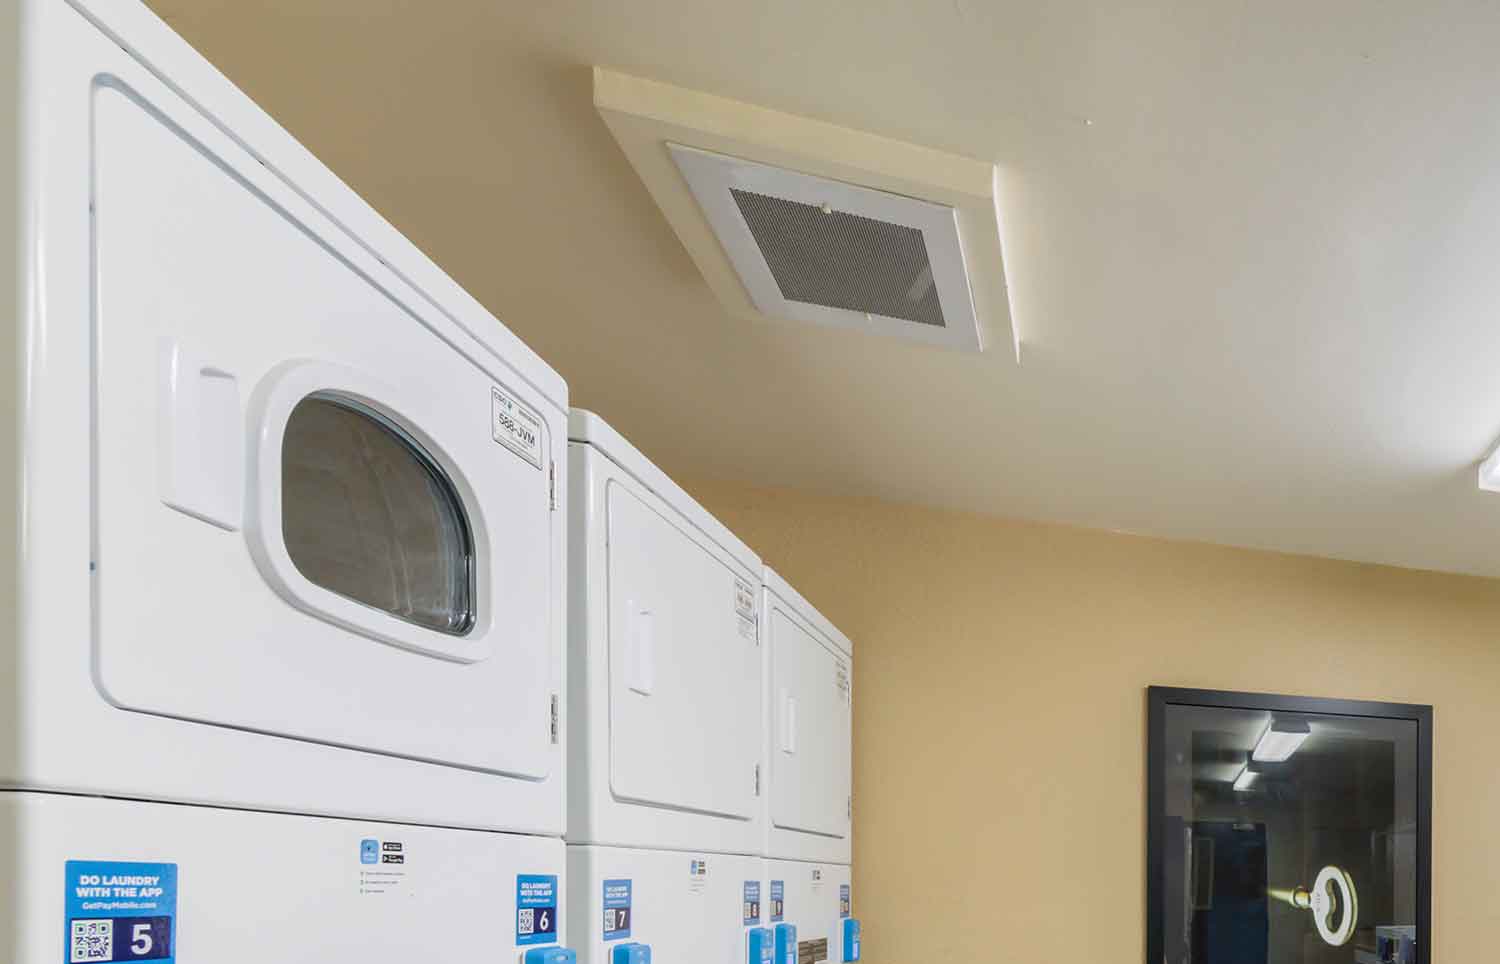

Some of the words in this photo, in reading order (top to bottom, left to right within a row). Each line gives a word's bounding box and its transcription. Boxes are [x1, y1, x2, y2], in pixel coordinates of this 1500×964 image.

[80, 875, 100, 886] DO
[102, 875, 160, 887] LAUNDRY
[75, 887, 111, 898] WITH
[113, 887, 137, 897] THE
[139, 887, 163, 897] APP
[539, 911, 549, 931] 6
[619, 911, 626, 928] 7
[130, 923, 153, 956] 5
